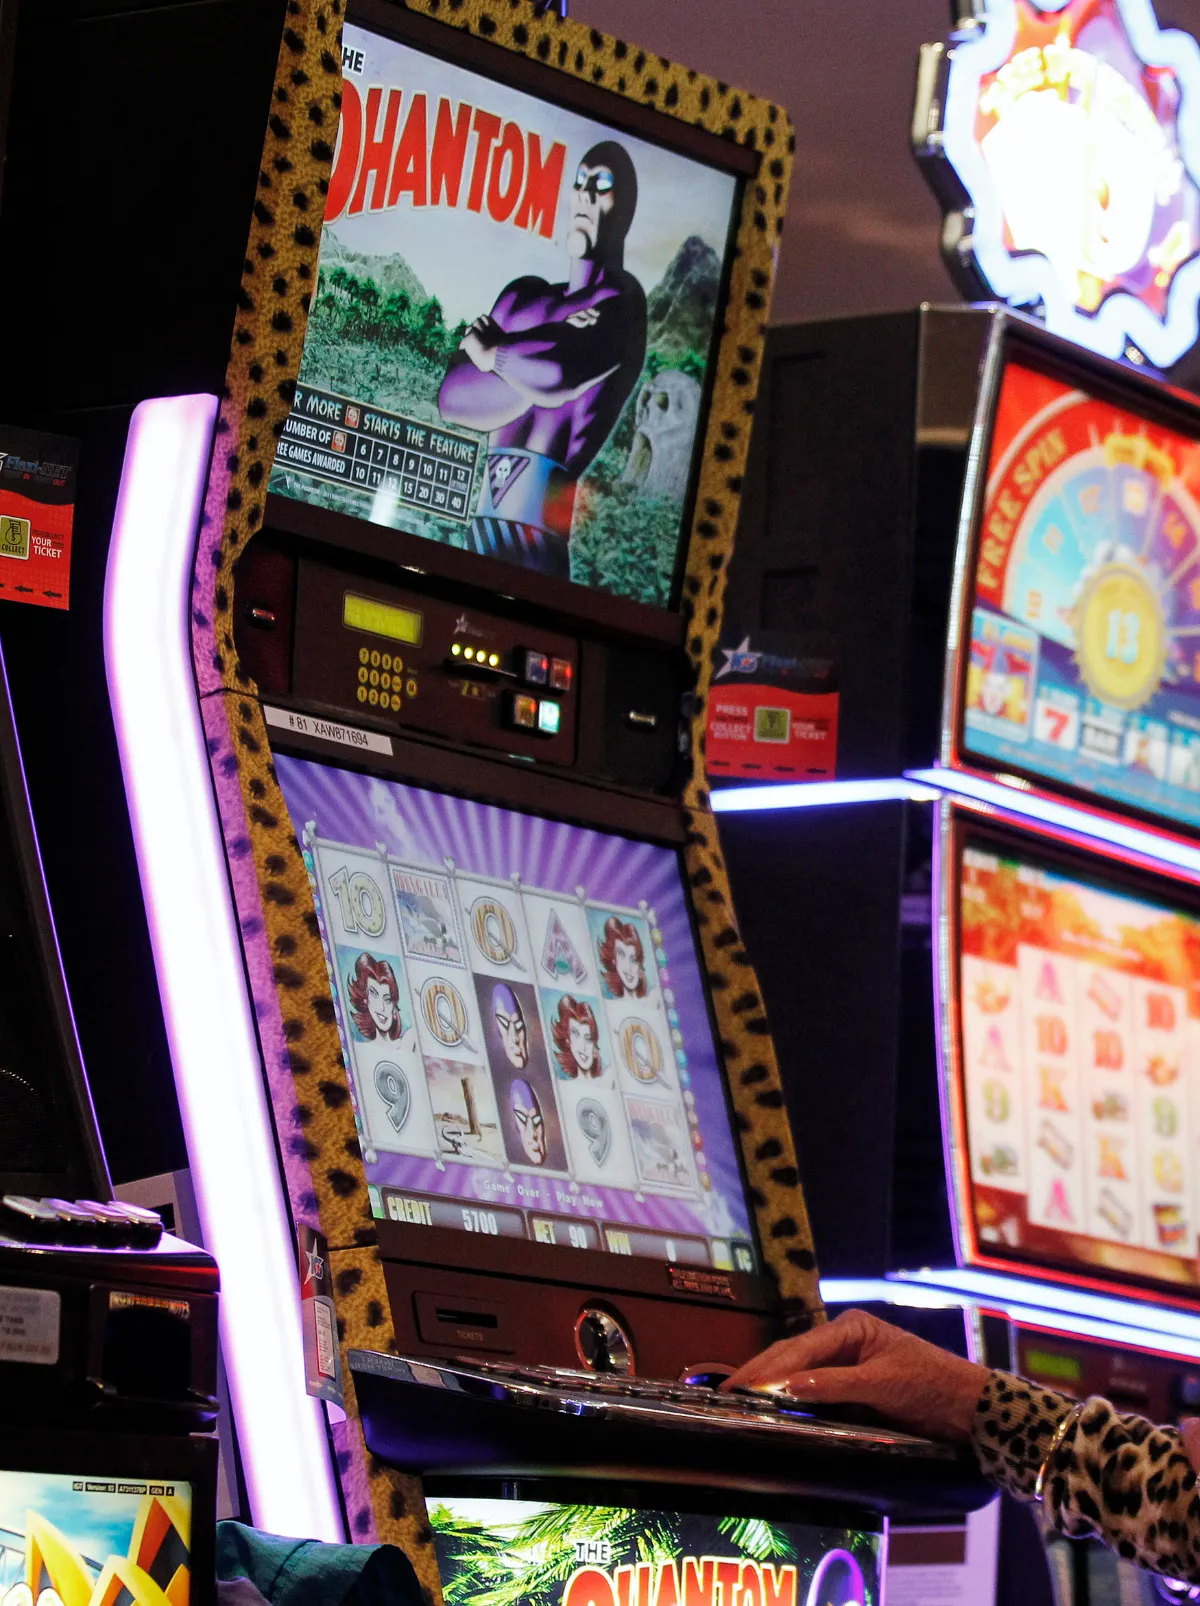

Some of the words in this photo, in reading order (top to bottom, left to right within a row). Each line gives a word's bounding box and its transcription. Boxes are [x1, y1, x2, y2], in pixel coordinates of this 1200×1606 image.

[342, 46, 365, 73] HE
[283, 418, 316, 439] UMBER
[318, 430, 331, 444] OF
[306, 395, 343, 421] MORE
[363, 413, 401, 440] STARTS
[406, 424, 427, 444] THE
[430, 433, 476, 463] FEATURE
[361, 445, 366, 455] 6
[378, 450, 383, 460] 7
[288, 445, 312, 463] GAMES
[312, 453, 345, 473] AWARDED
[393, 455, 399, 465] 8
[409, 460, 414, 470] 9
[355, 466, 365, 479] 10
[423, 463, 432, 476] 10
[440, 470, 448, 481] 11
[457, 470, 465, 481] 12
[372, 472, 381, 484] 11
[388, 477, 397, 489] 12
[404, 482, 413, 494] 15
[419, 487, 428, 499] 20
[435, 492, 445, 504] 30
[451, 497, 461, 509] 40
[978, 490, 1020, 588] FREE
[1012, 428, 1068, 491] SPIN
[31, 536, 51, 547] YOUR
[33, 545, 62, 558] TICKET
[289, 715, 294, 727] #
[297, 717, 307, 731] 81
[313, 721, 368, 746] XAW871694
[484, 1181, 510, 1194] Game
[517, 1185, 539, 1198] Over
[556, 1192, 577, 1208] Play
[387, 1196, 433, 1226] CREDIT
[461, 1209, 498, 1236] 5700
[532, 1218, 556, 1244] BET
[568, 1225, 588, 1249] 90
[605, 1229, 632, 1256] WIN
[666, 1239, 677, 1262] 0
[577, 1541, 608, 1561] THE
